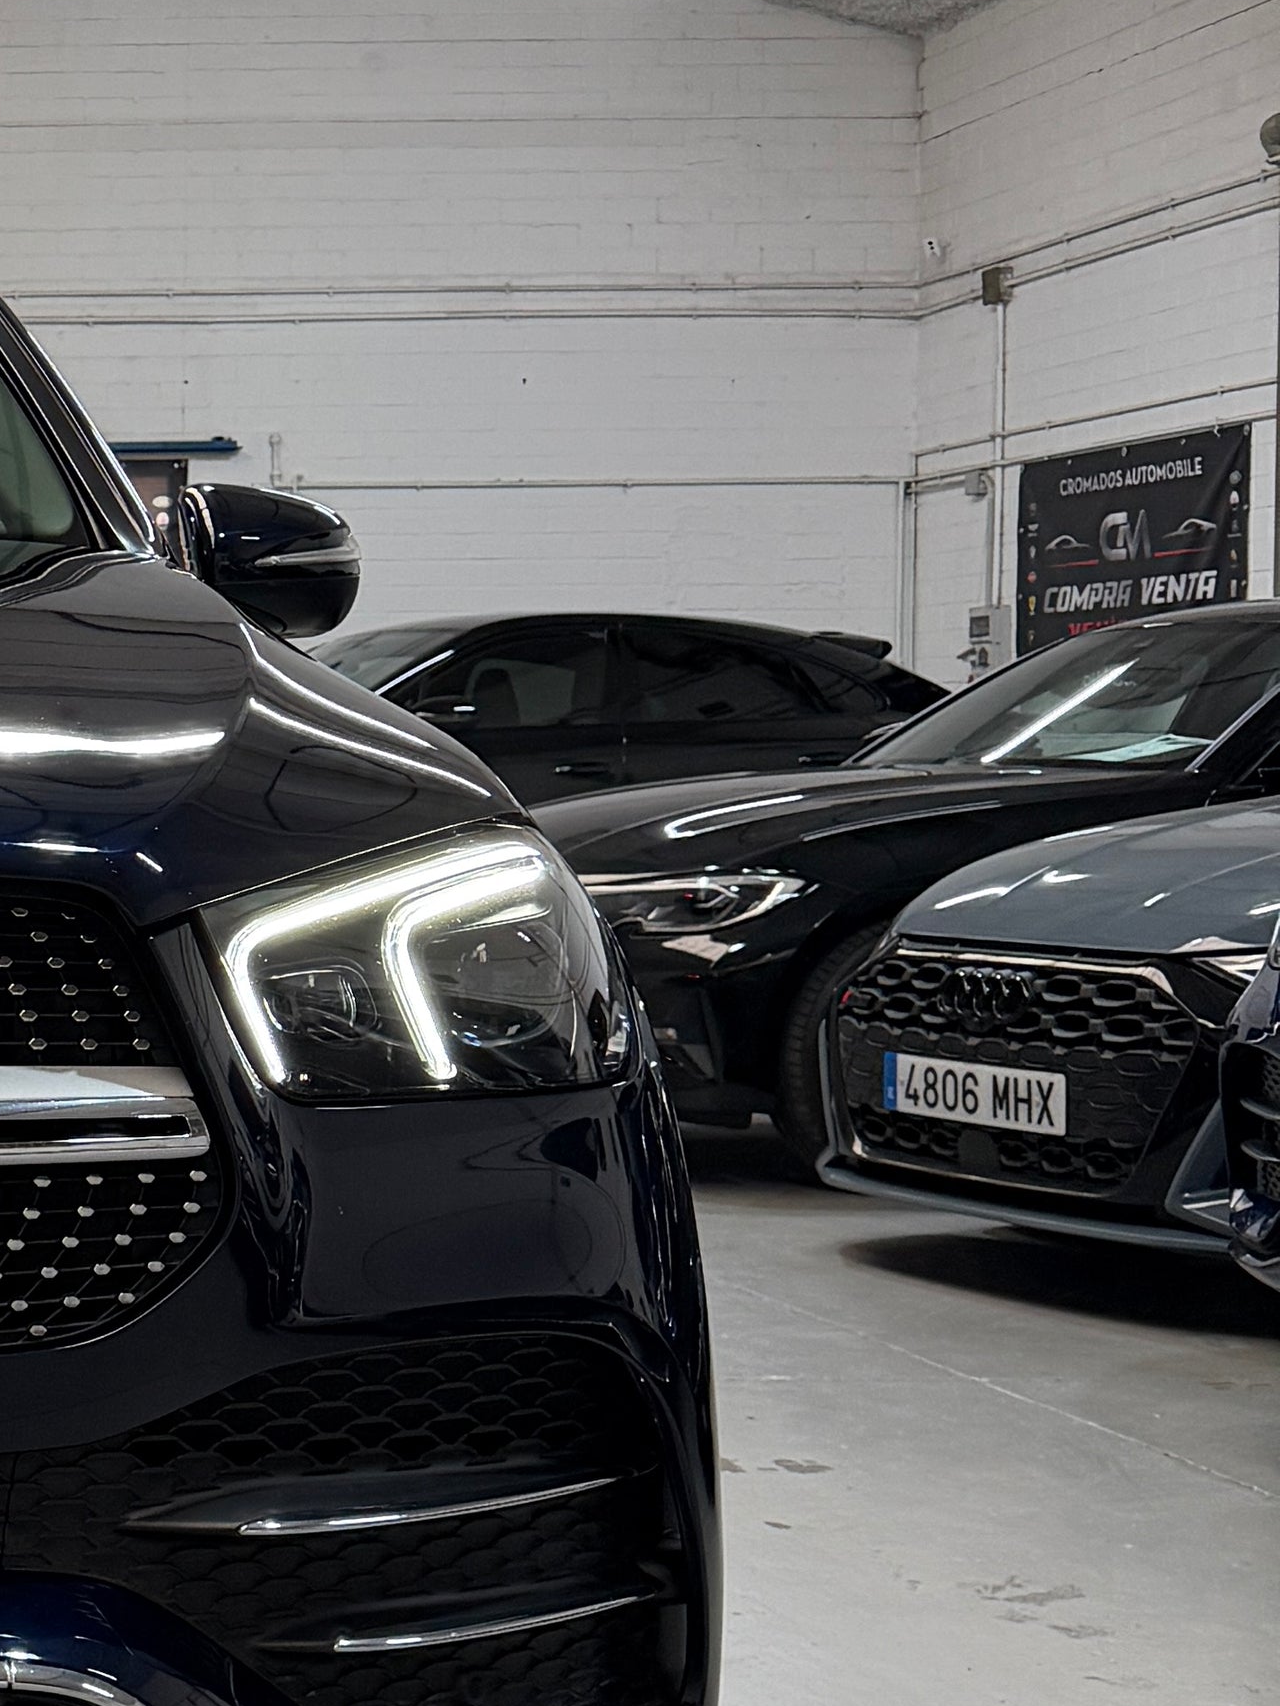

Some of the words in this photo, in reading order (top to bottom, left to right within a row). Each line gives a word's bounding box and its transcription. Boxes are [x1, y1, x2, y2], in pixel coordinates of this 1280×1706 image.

[1060, 469, 1123, 496] CROMADOS
[1125, 457, 1203, 485] AUTOMOBILE
[1043, 580, 1132, 614] COMPRA
[1140, 570, 1218, 605] VENTA
[905, 1064, 979, 1114] 4806
[992, 1075, 1055, 1127] MHX
